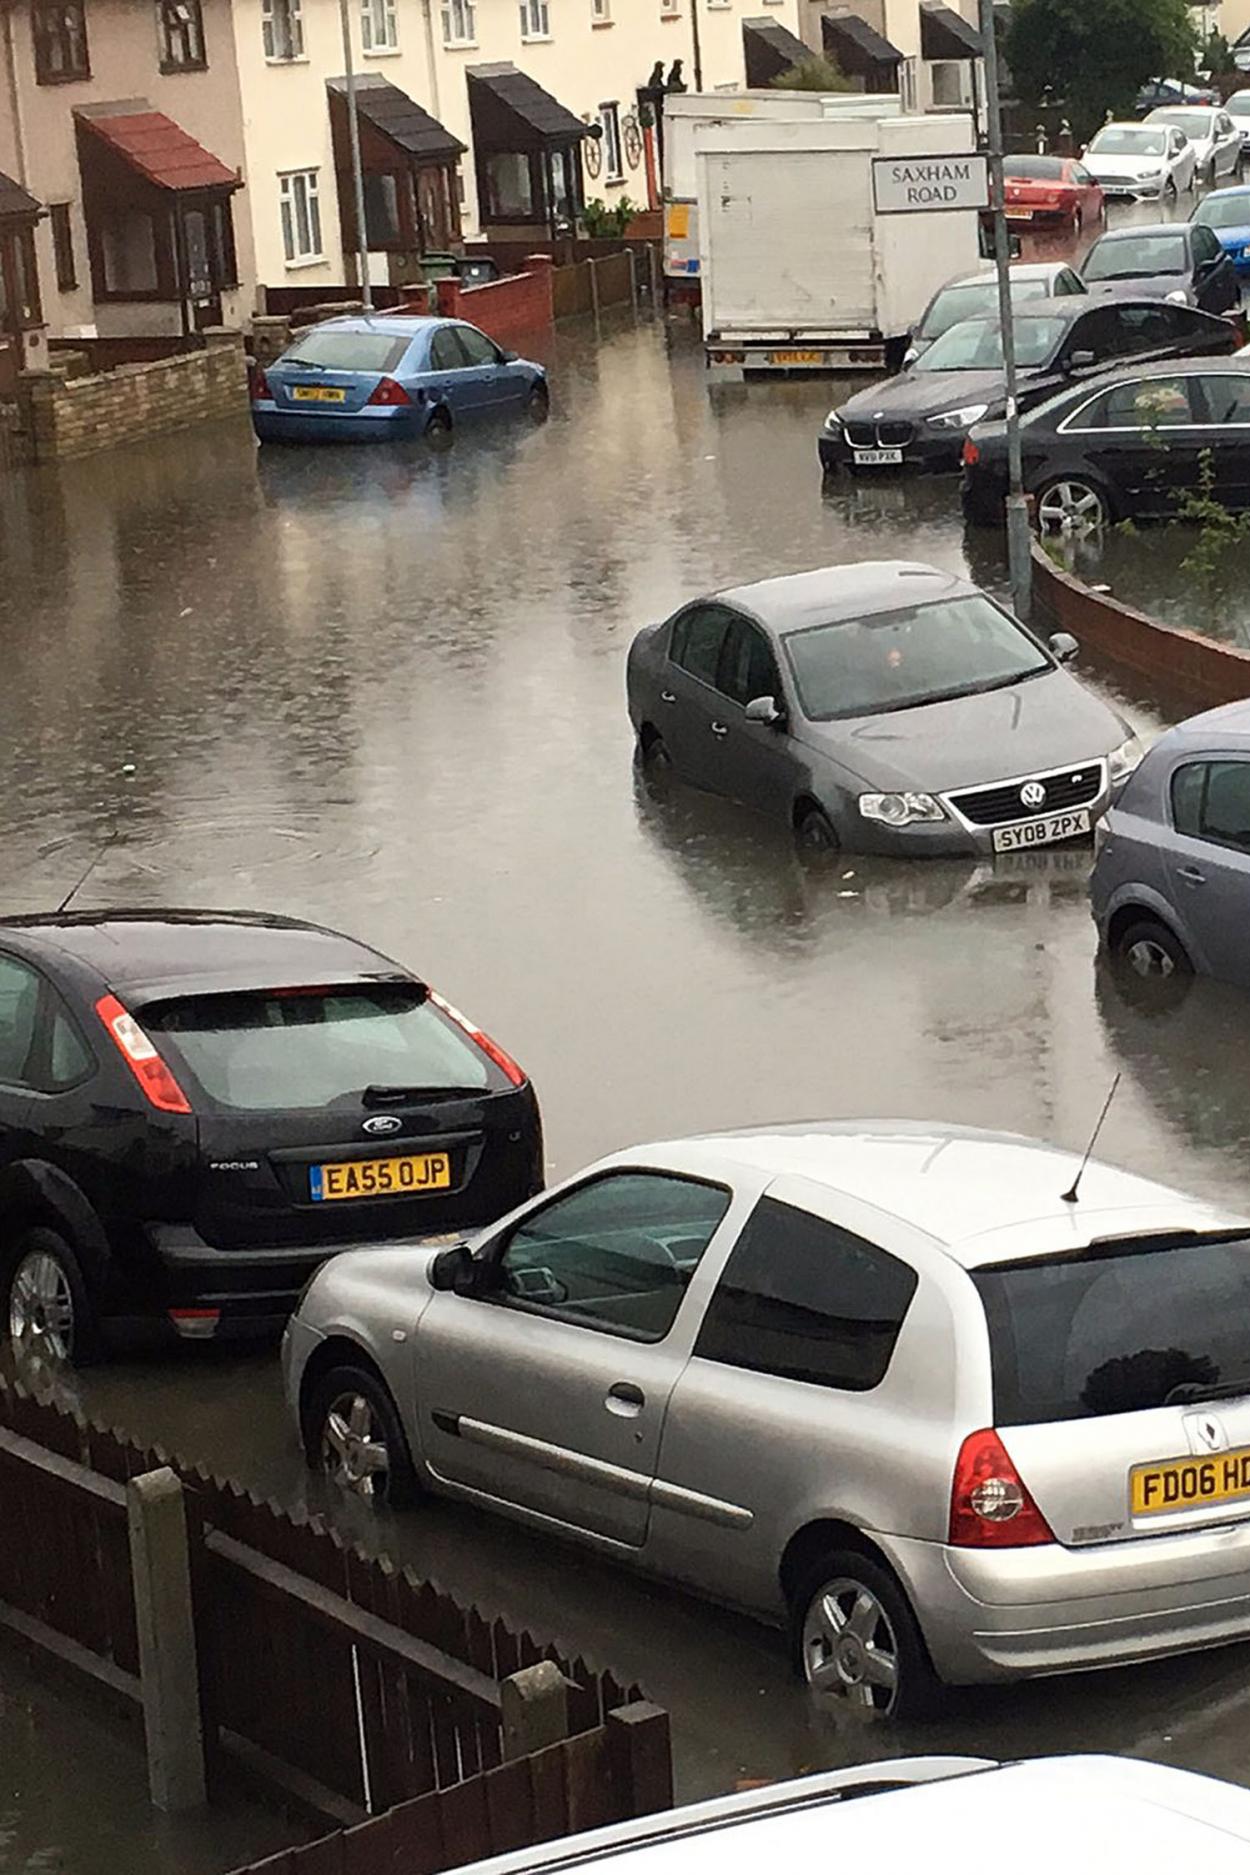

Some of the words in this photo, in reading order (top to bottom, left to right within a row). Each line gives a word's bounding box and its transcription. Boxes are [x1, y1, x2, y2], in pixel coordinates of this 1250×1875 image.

[892, 164, 970, 184] SAXHAM
[907, 186, 957, 203] ROAD
[1001, 823, 1047, 847] SY08
[1050, 815, 1083, 837] ZPX
[210, 1161, 258, 1170] FOCUS
[326, 1163, 393, 1194] EA55
[399, 1158, 445, 1186] OJP
[1143, 1463, 1216, 1506] FD06
